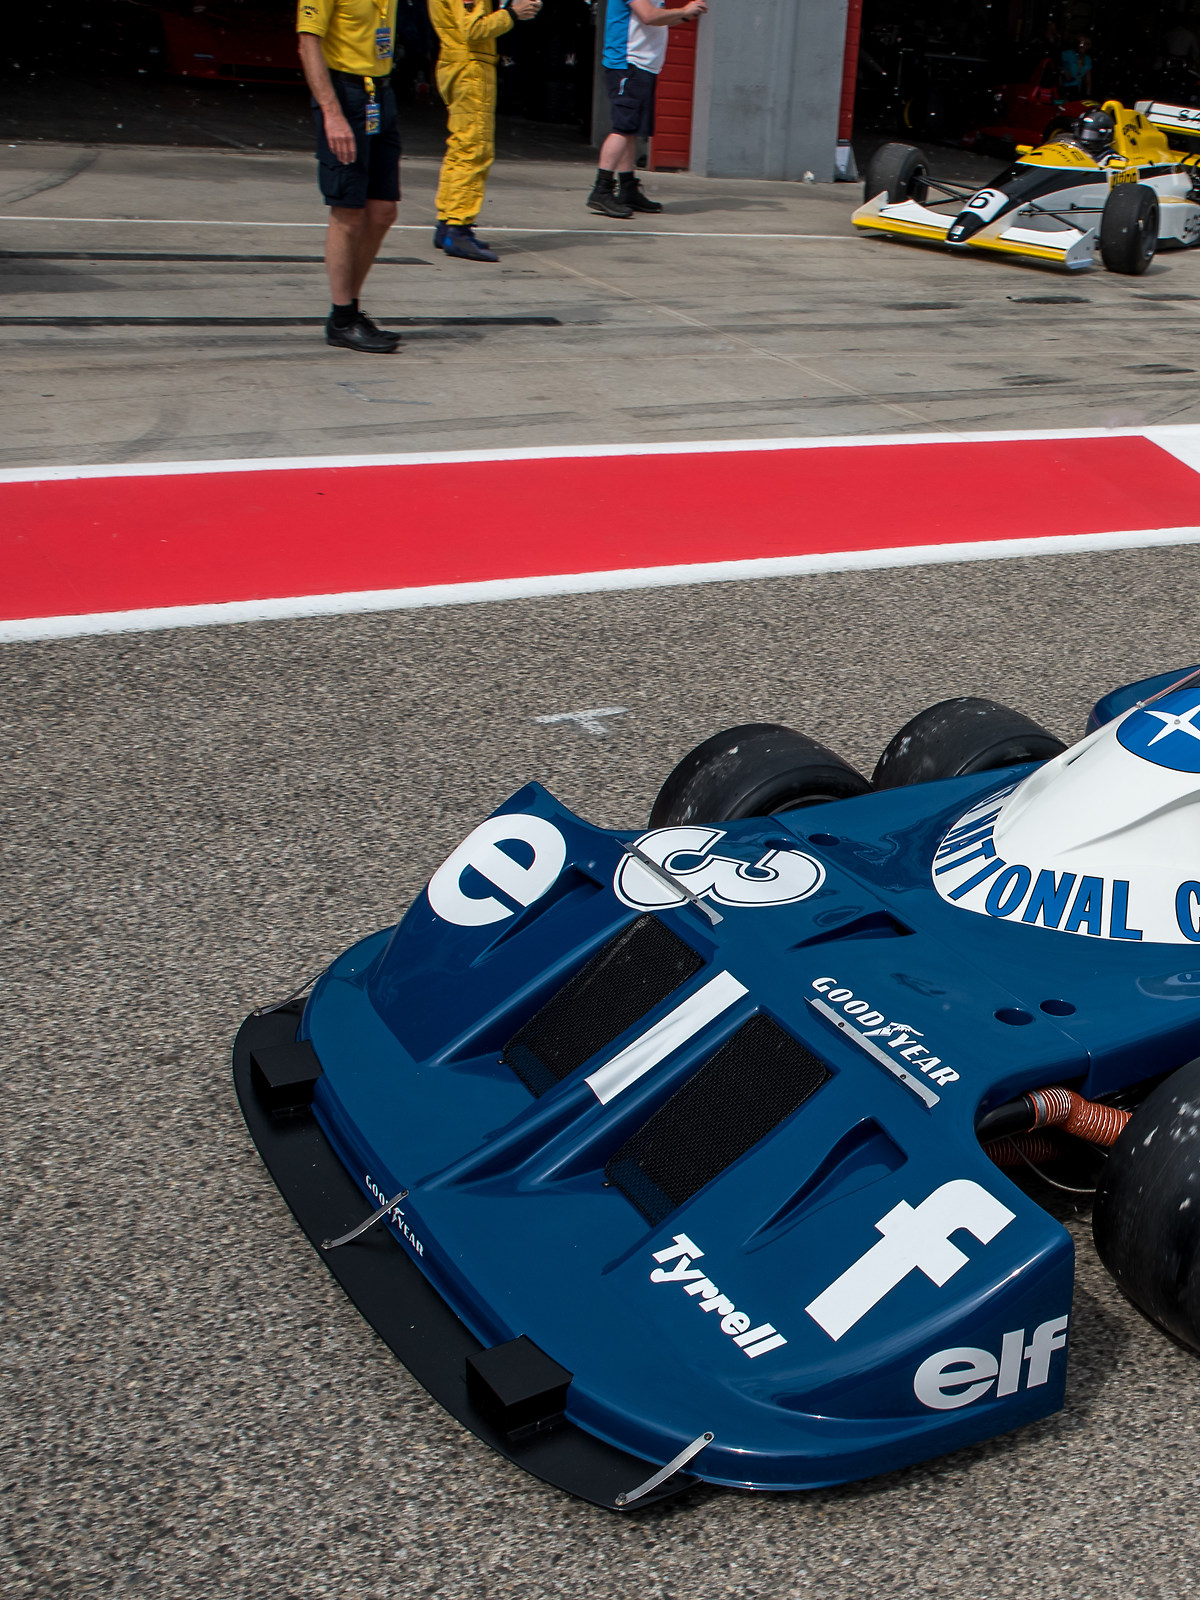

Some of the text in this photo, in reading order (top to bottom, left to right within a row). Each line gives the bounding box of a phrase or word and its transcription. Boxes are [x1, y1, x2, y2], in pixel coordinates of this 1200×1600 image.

[968, 191, 995, 209] 6
[613, 825, 827, 911] 3
[811, 977, 961, 1087] GOODYEAR
[650, 1233, 788, 1359] Tyrrell
[913, 1314, 1069, 1410] elf
